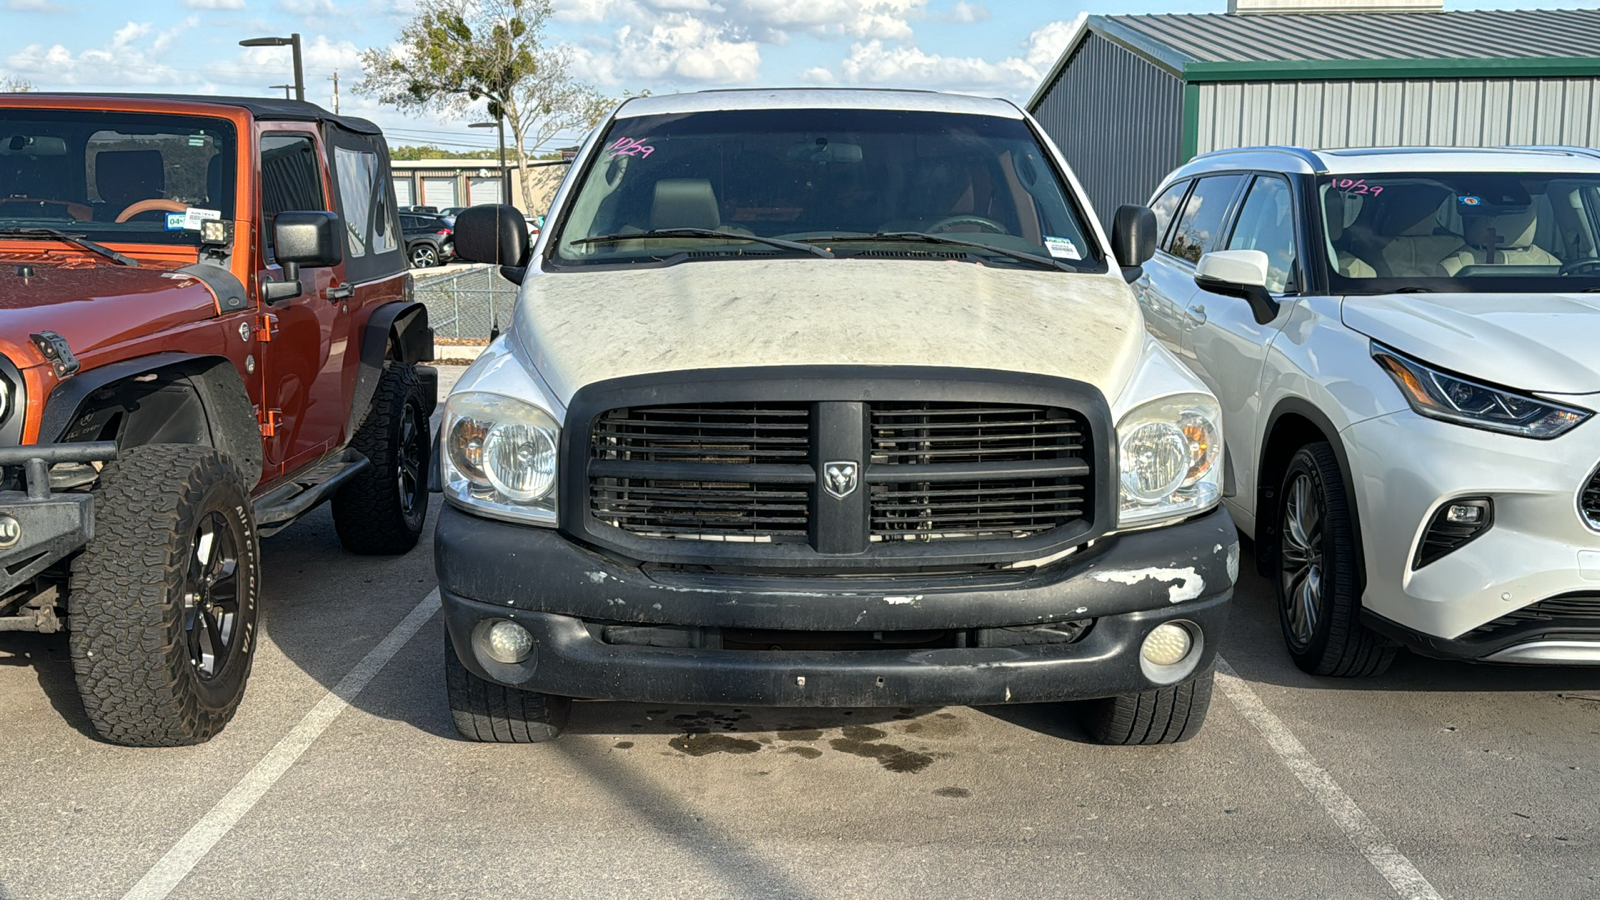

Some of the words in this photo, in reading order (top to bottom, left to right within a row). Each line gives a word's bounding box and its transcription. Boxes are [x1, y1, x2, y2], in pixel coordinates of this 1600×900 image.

[607, 136, 655, 159] 10/29
[1332, 178, 1384, 197] 10/29
[235, 504, 255, 610] All-Terrain
[242, 622, 253, 653] T/A
